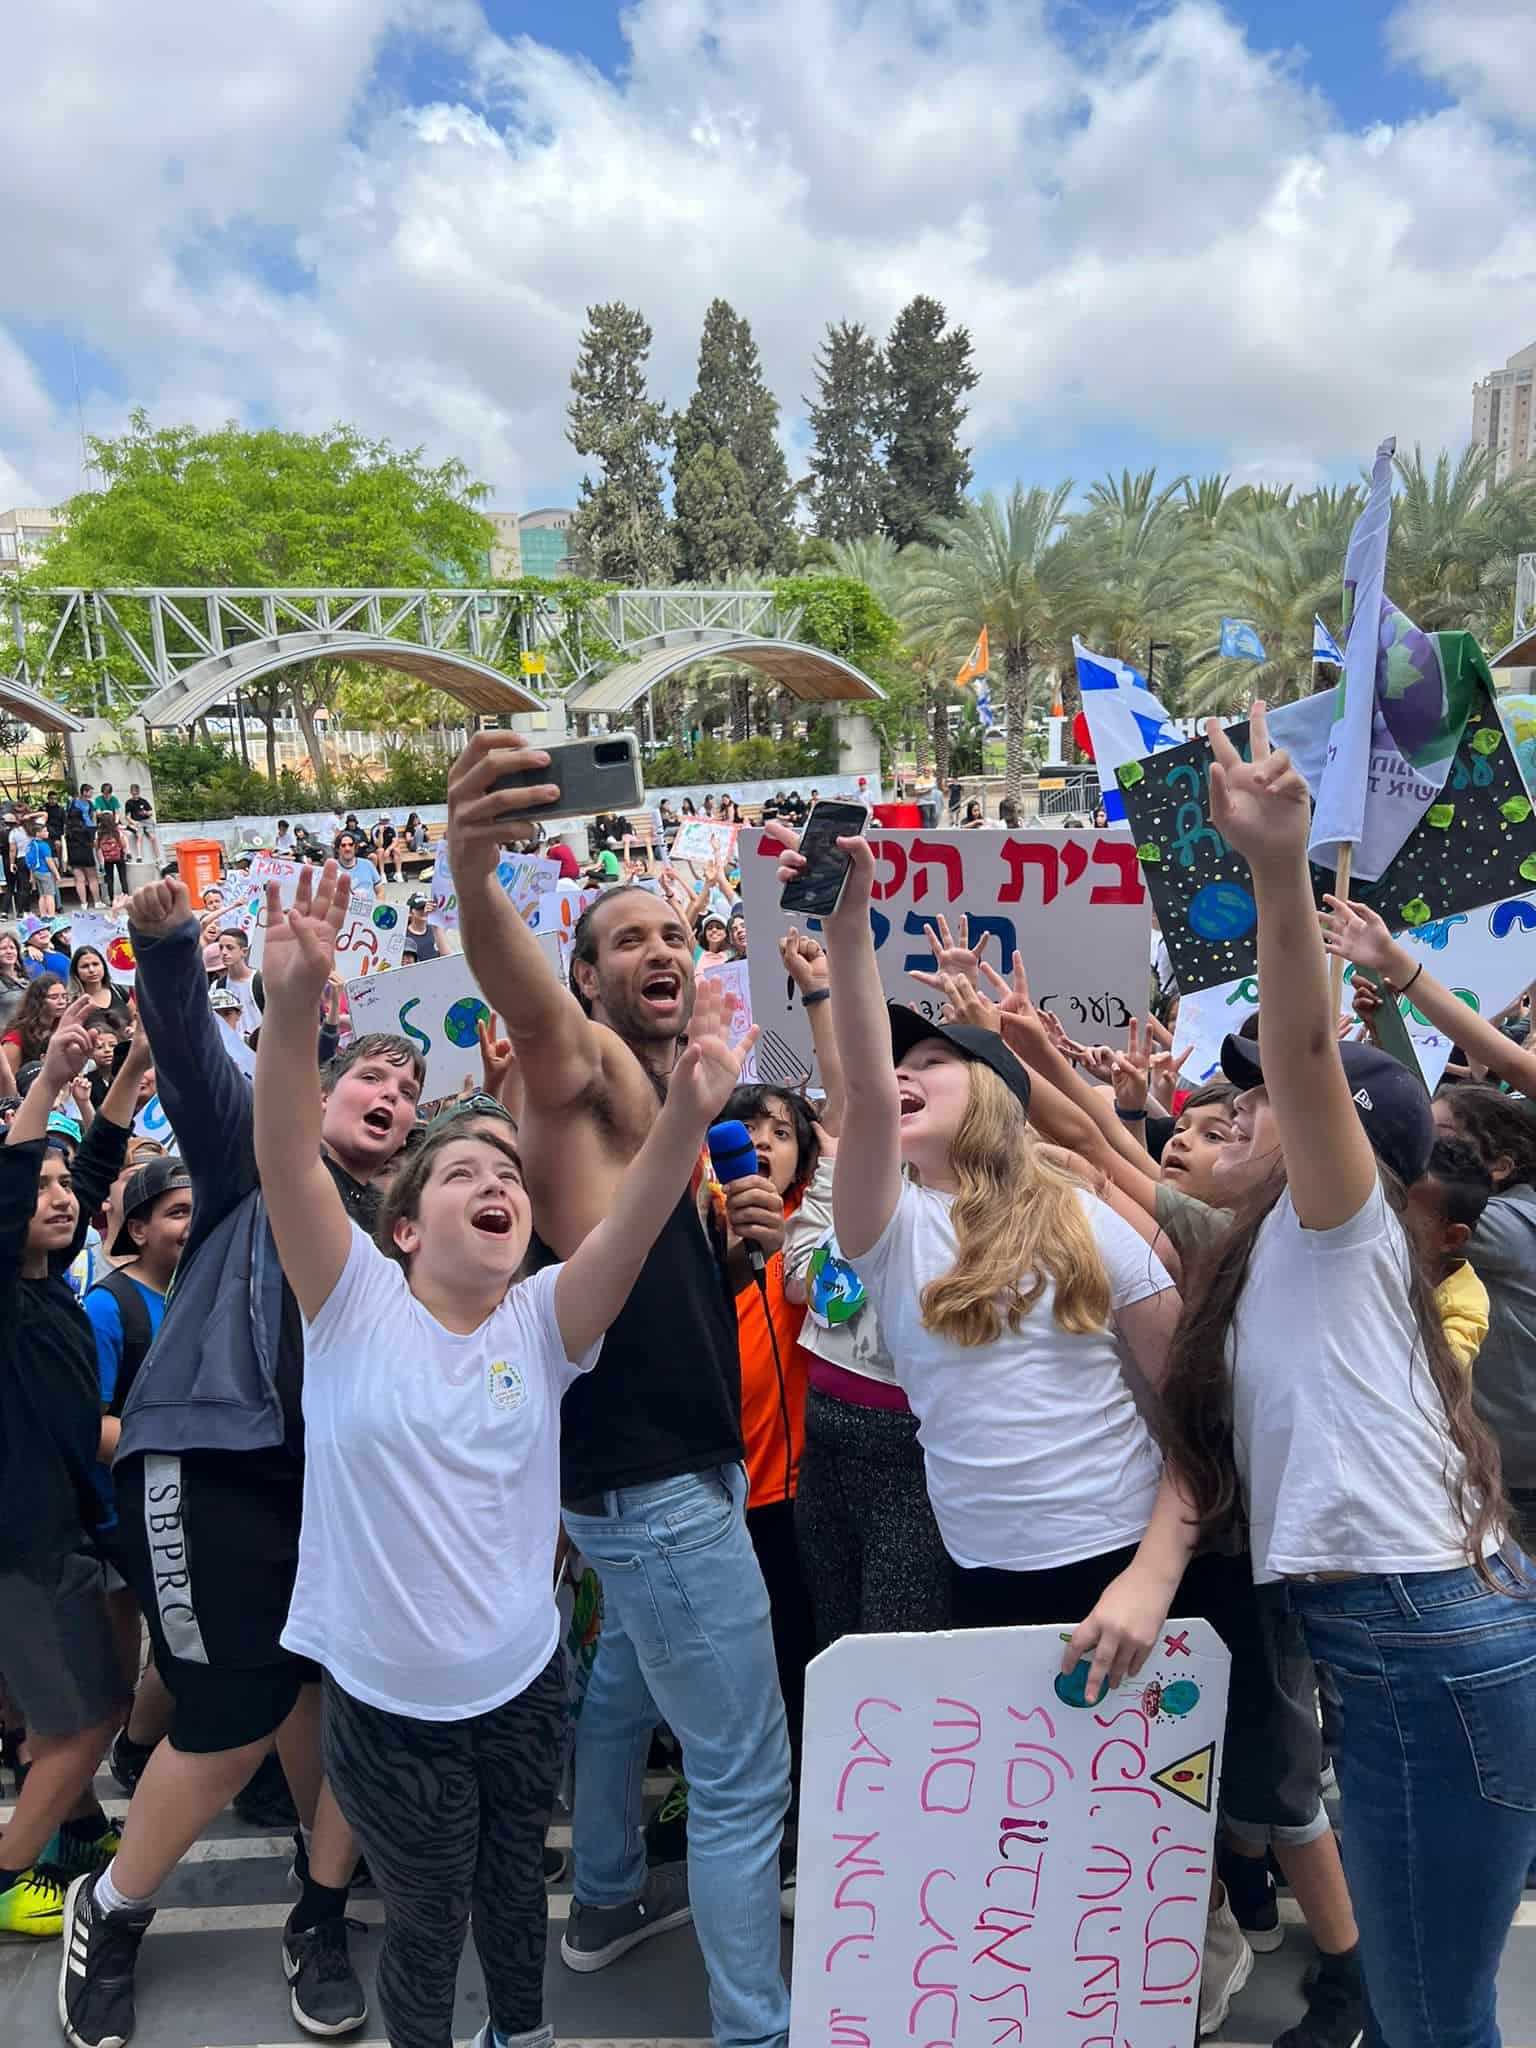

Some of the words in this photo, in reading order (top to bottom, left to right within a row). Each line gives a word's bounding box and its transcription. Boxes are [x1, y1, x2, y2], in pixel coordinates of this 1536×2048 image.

[997, 838, 1146, 905] בית
[836, 1696, 902, 1812] מה
[920, 1697, 982, 1815] שם
[825, 1830, 886, 1973] אתה
